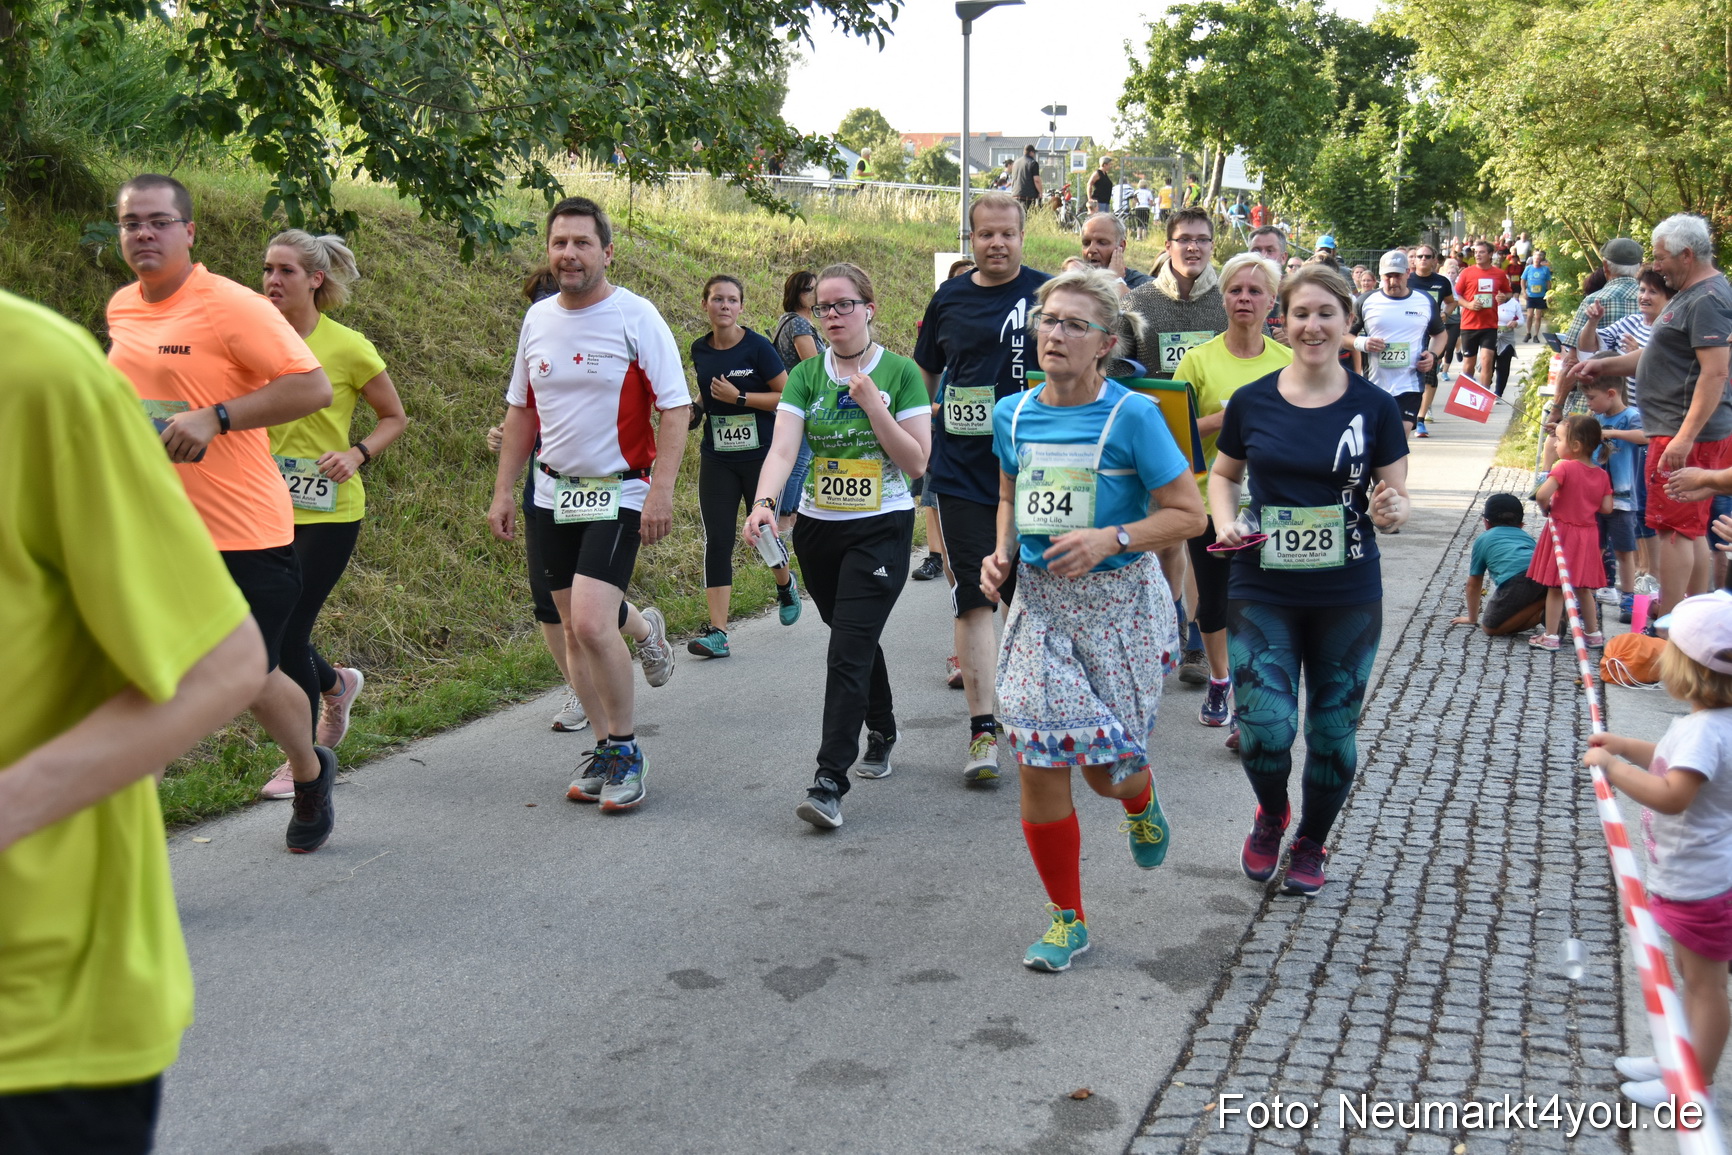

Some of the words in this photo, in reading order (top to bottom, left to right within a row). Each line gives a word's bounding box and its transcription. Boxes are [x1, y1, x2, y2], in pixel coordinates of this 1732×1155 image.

[158, 345, 191, 355] THULE
[1166, 346, 1194, 361] 20
[1381, 351, 1406, 361] 2273
[947, 403, 987, 422] 1933
[717, 428, 751, 441] 1449
[821, 476, 871, 497] 2088
[560, 490, 611, 509] 2089
[1027, 491, 1073, 516] 834
[1271, 528, 1333, 552] 1928
